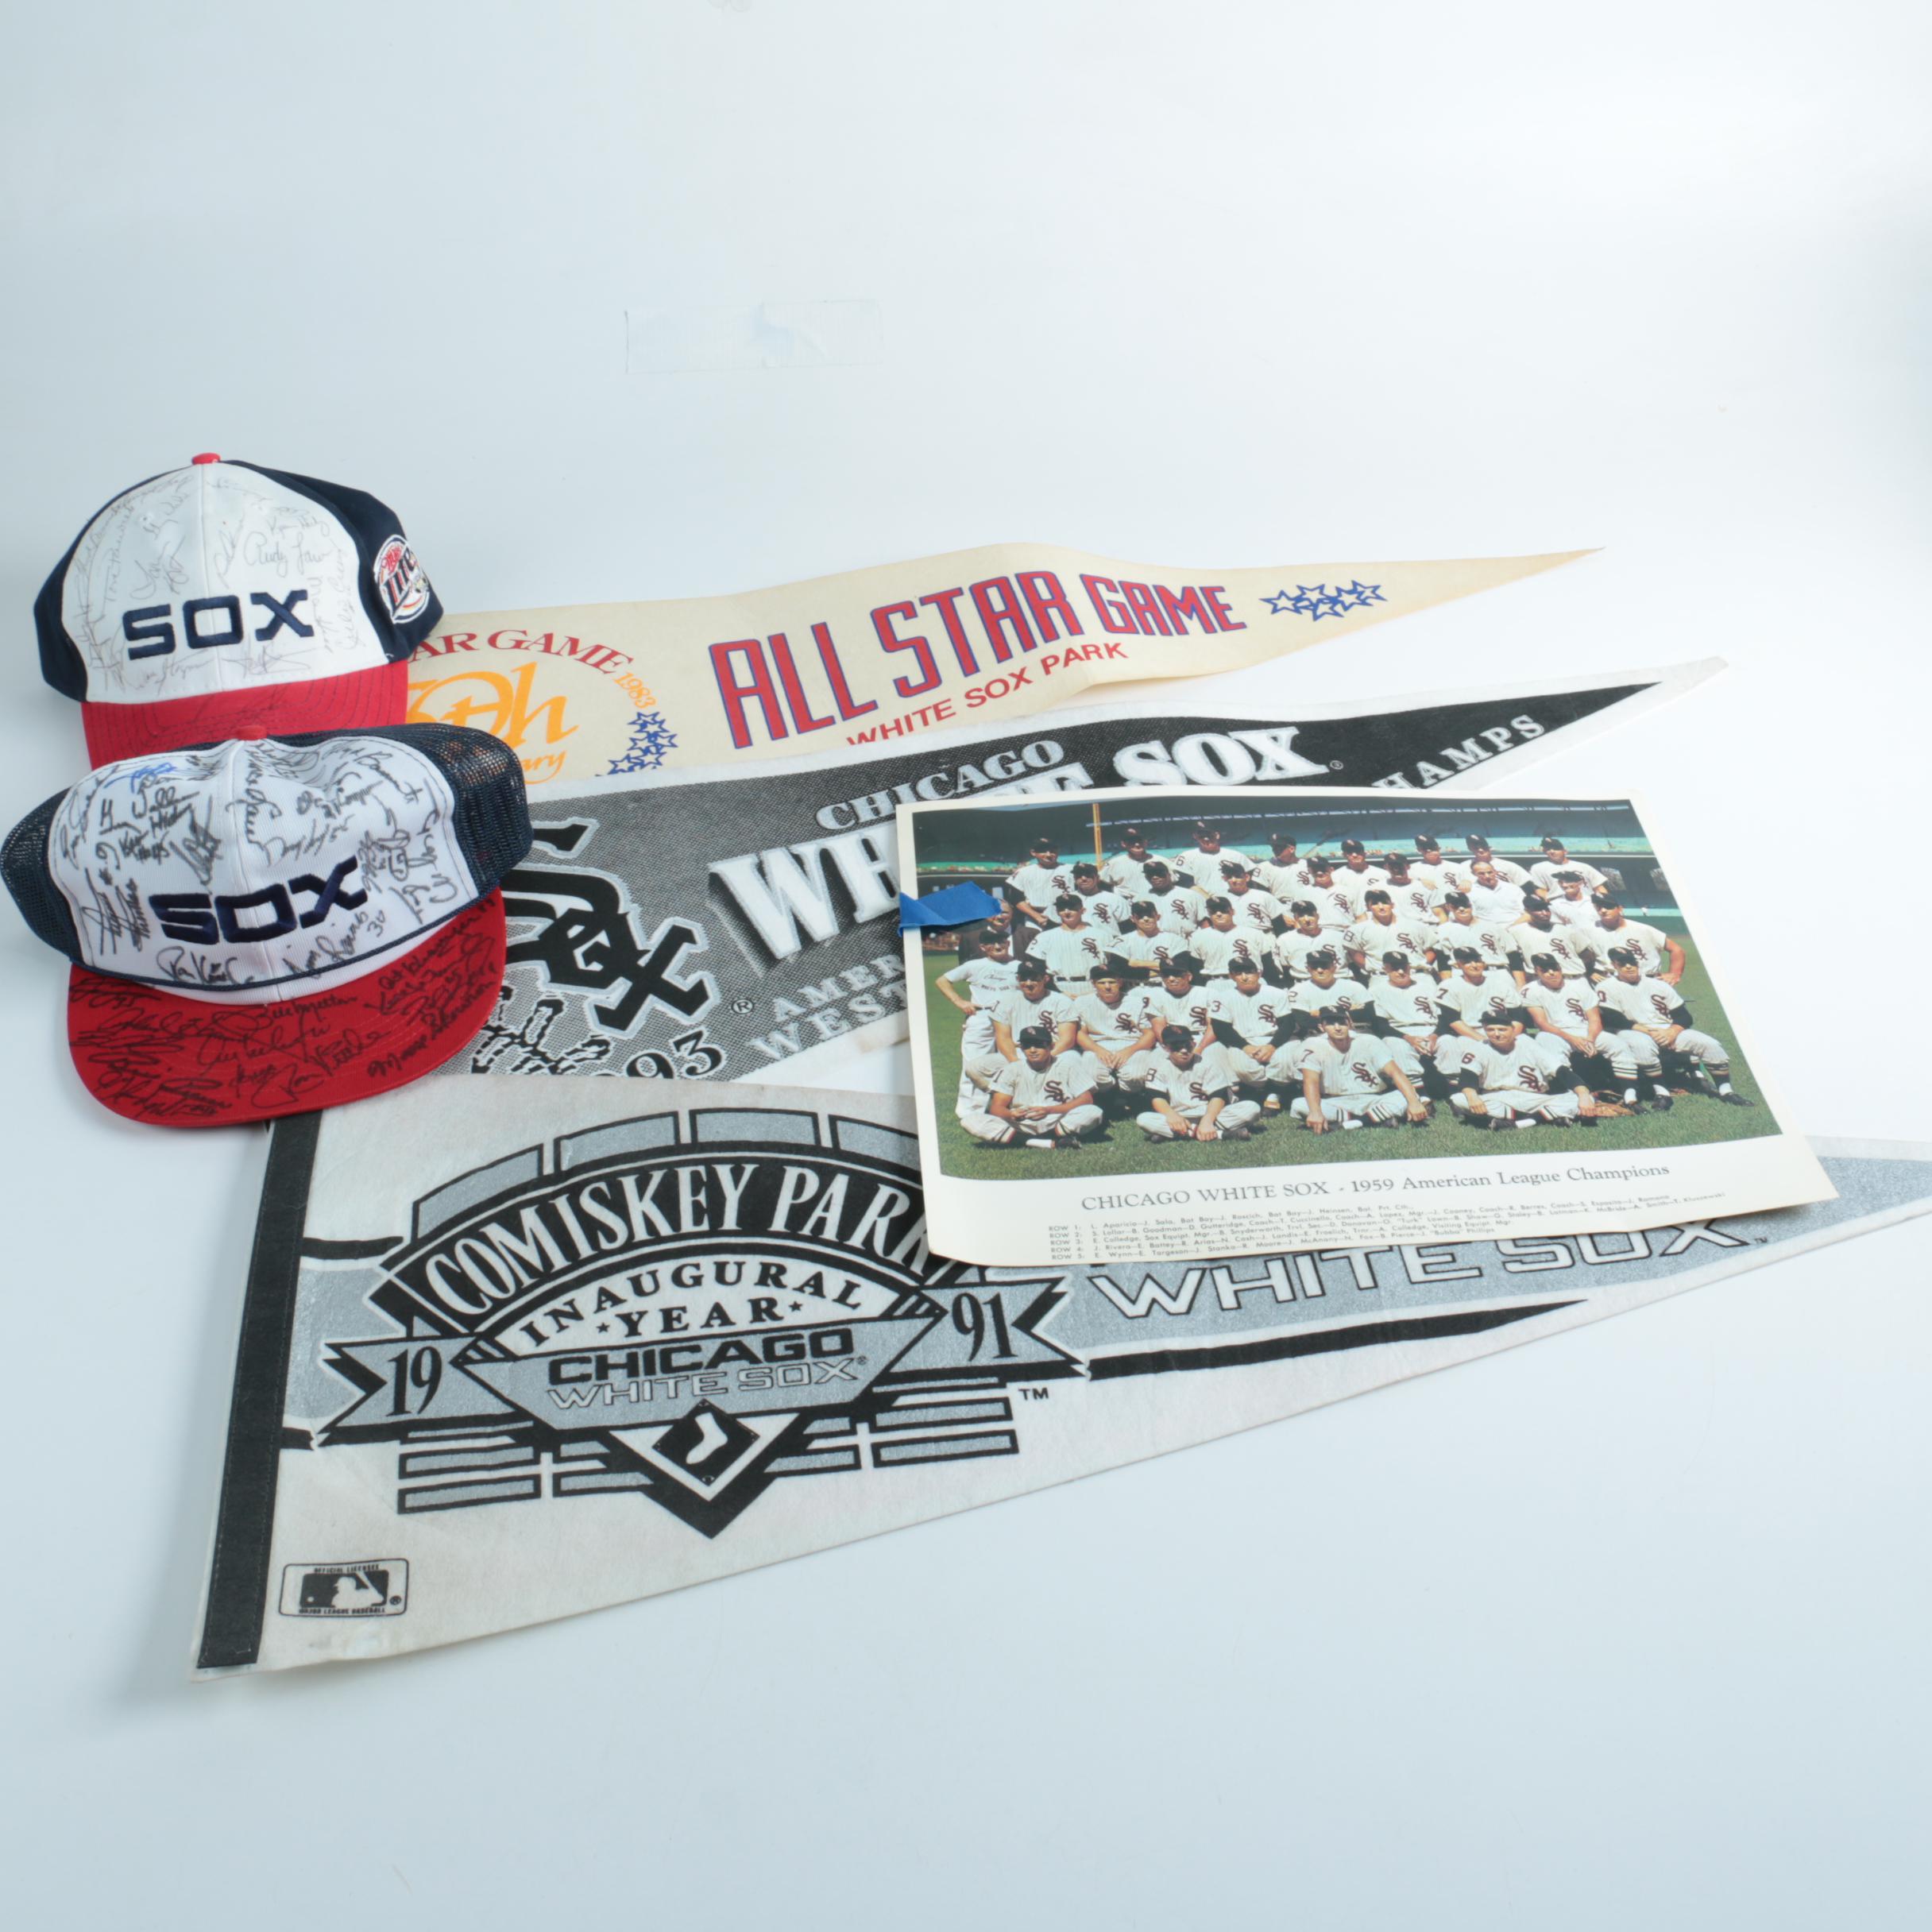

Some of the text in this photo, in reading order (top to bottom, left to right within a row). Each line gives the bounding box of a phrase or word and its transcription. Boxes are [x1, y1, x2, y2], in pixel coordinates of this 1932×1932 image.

[122, 589, 315, 661] SOX
[709, 570, 1248, 749] ALL STAR GAME
[408, 629, 657, 709] AR GAME 1983
[846, 641, 1129, 747] WHITE SOX PARK
[815, 740, 1065, 831] CHICAGO
[1114, 726, 1331, 786] SOX
[1371, 714, 1545, 789] HAMPS
[149, 855, 369, 946] SOX
[773, 954, 906, 1022] AMER
[1081, 1190, 1191, 1211] CHICAGO
[1197, 1184, 1277, 1202] WHITE
[1282, 1180, 1331, 1197] SOX
[1350, 1177, 1394, 1192] 1959
[1403, 1173, 1492, 1191] American
[1496, 1171, 1561, 1186] League
[1566, 1165, 1671, 1182] Champions
[425, 1164, 759, 1316] COMISKEY
[520, 1261, 862, 1347] INAUGURAL
[615, 1295, 780, 1338] YEAR
[1088, 1242, 1483, 1320] WHITE
[548, 1327, 856, 1385] CHICAGO
[952, 1292, 1019, 1362] 91
[387, 1346, 442, 1417] 19
[547, 1357, 860, 1409] WHITE SOX
